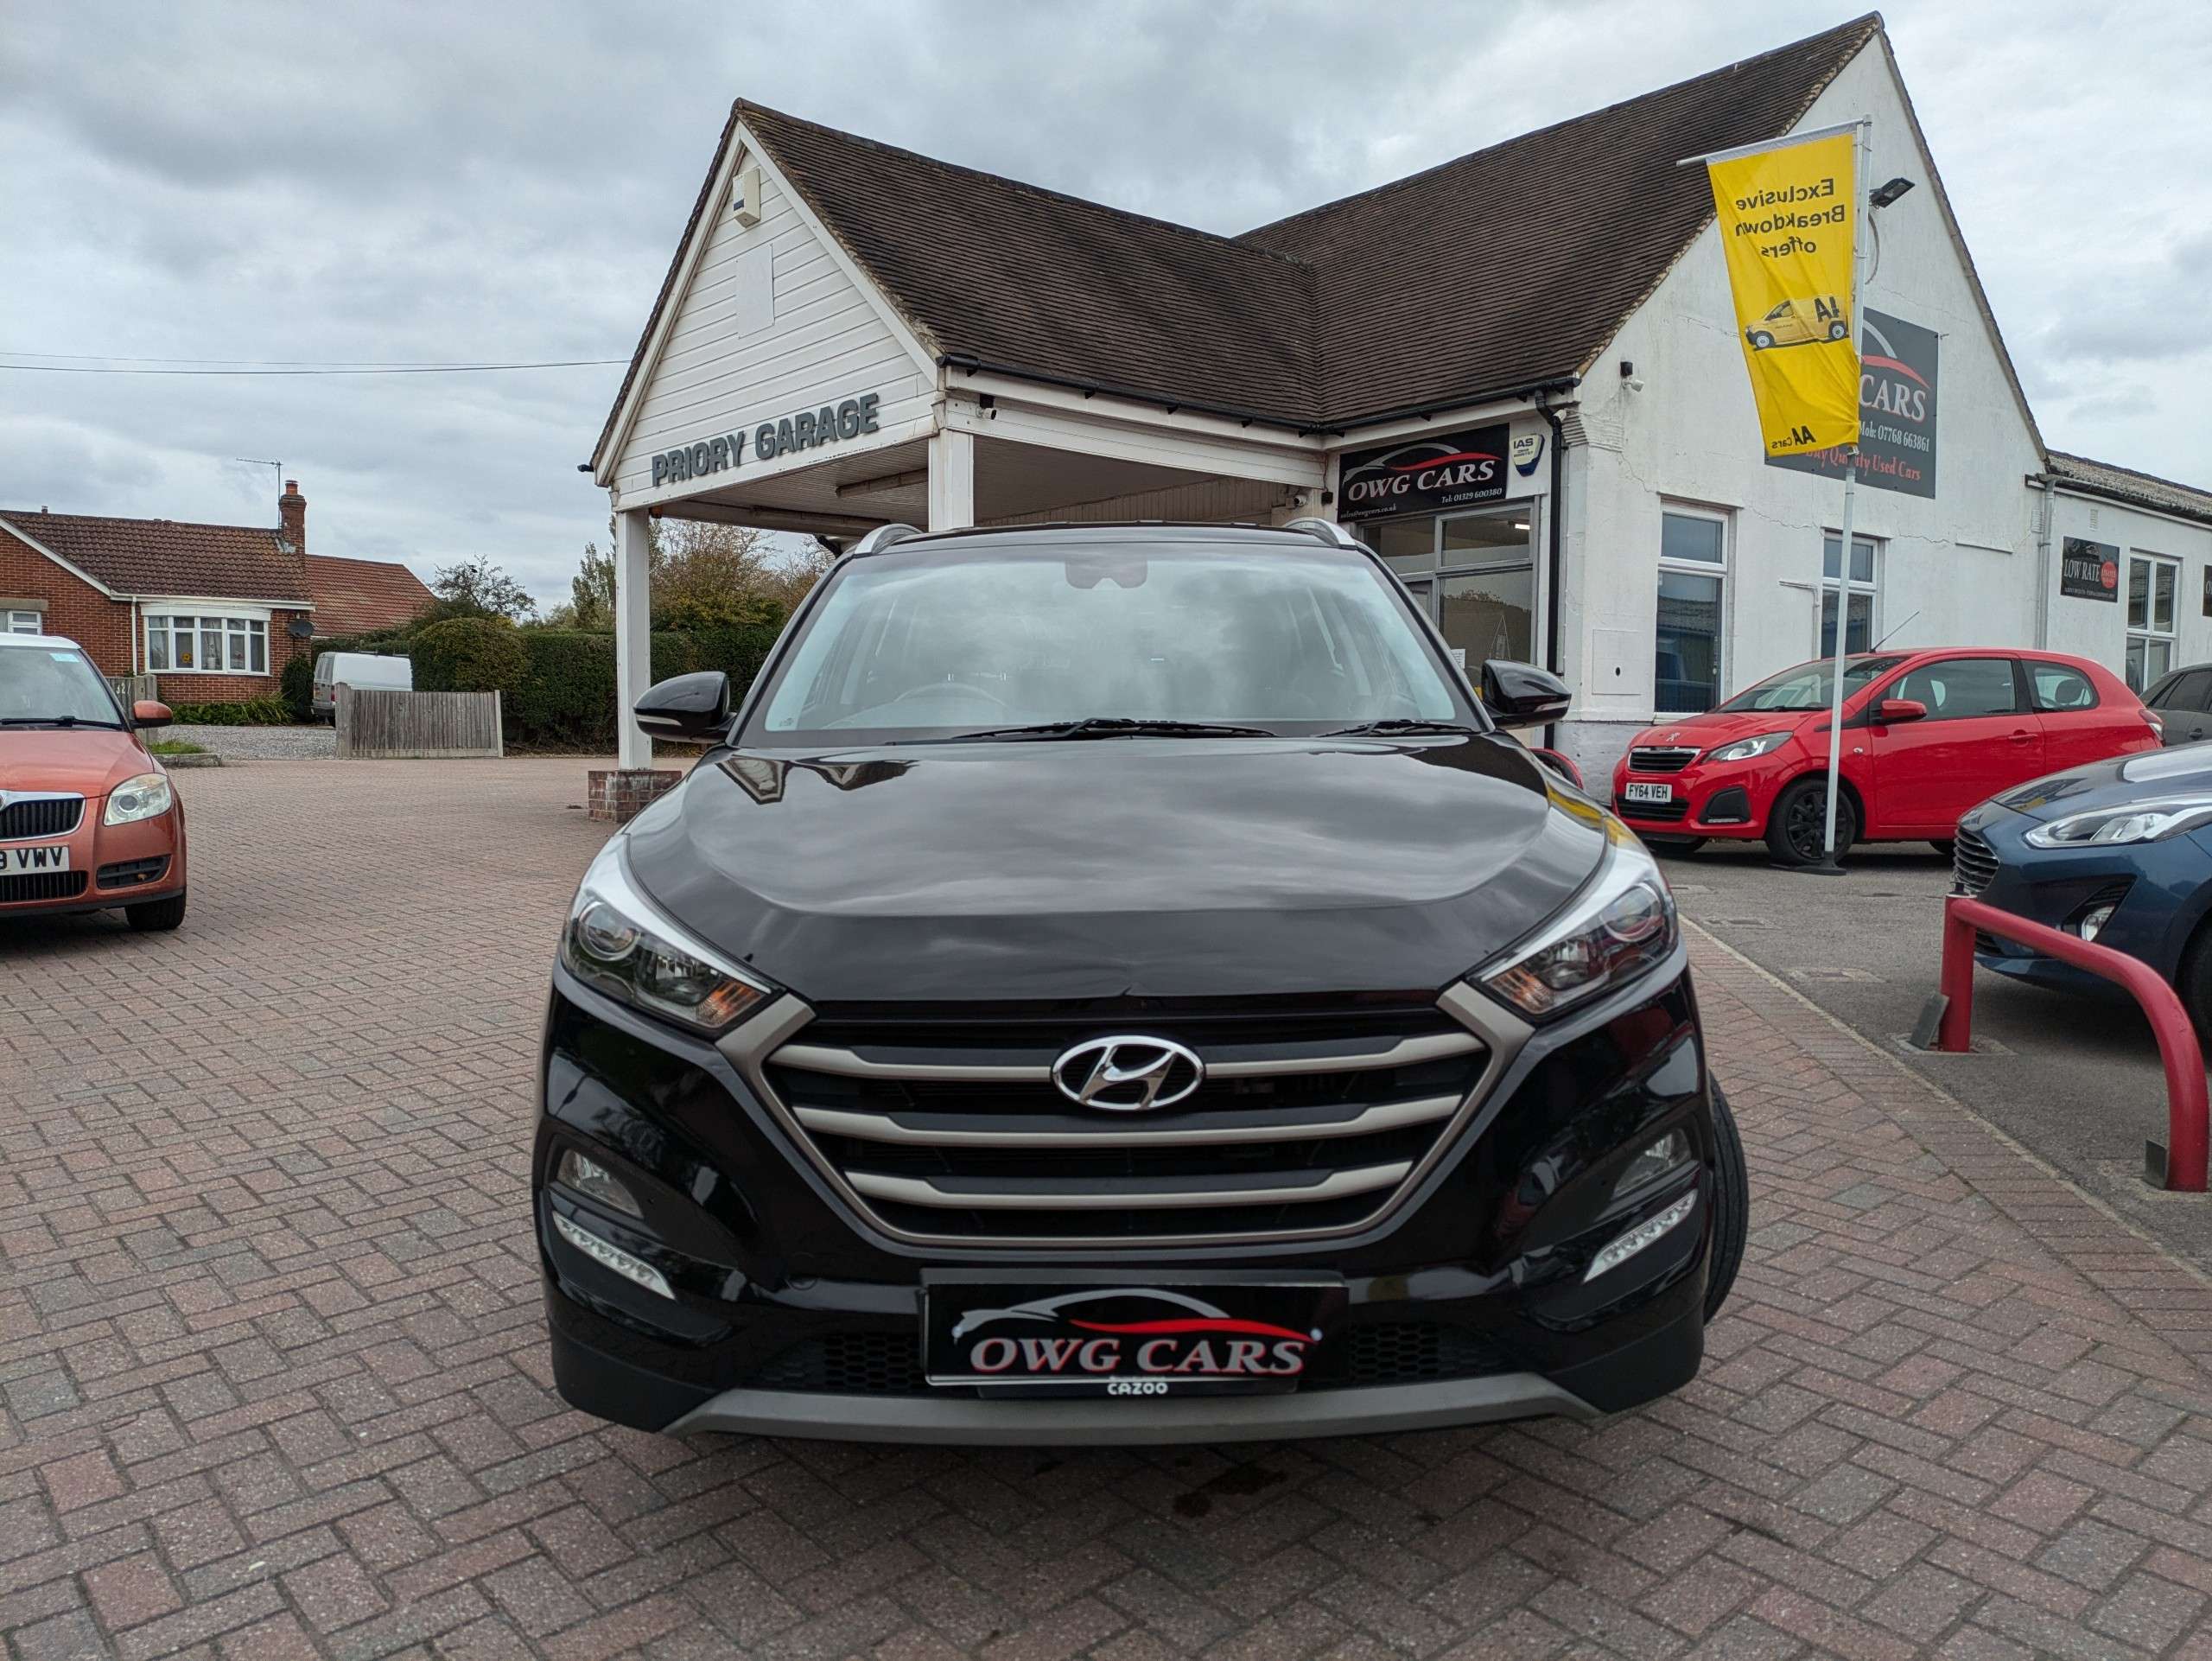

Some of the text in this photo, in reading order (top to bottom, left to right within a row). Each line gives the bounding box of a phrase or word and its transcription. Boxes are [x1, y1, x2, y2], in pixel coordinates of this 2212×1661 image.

[1859, 374, 1926, 423] CARS
[652, 392, 880, 487] PRIORY GARAGE
[1513, 437, 1534, 449] IAS
[1878, 425, 1902, 444] 07768
[1903, 431, 1929, 452] 663861
[1872, 455, 1896, 474] Used
[1899, 461, 1921, 480] Cars
[1349, 460, 1496, 501] OWG CARS
[1453, 492, 1473, 501] 01329
[2063, 559, 2082, 579] LOW
[2082, 562, 2101, 582] RATE
[1629, 785, 1668, 799] FY64 VEH
[16, 847, 62, 869] VWV
[969, 1338, 1305, 1375] OWG CARS
[1107, 1383, 1168, 1396] CAZOO
